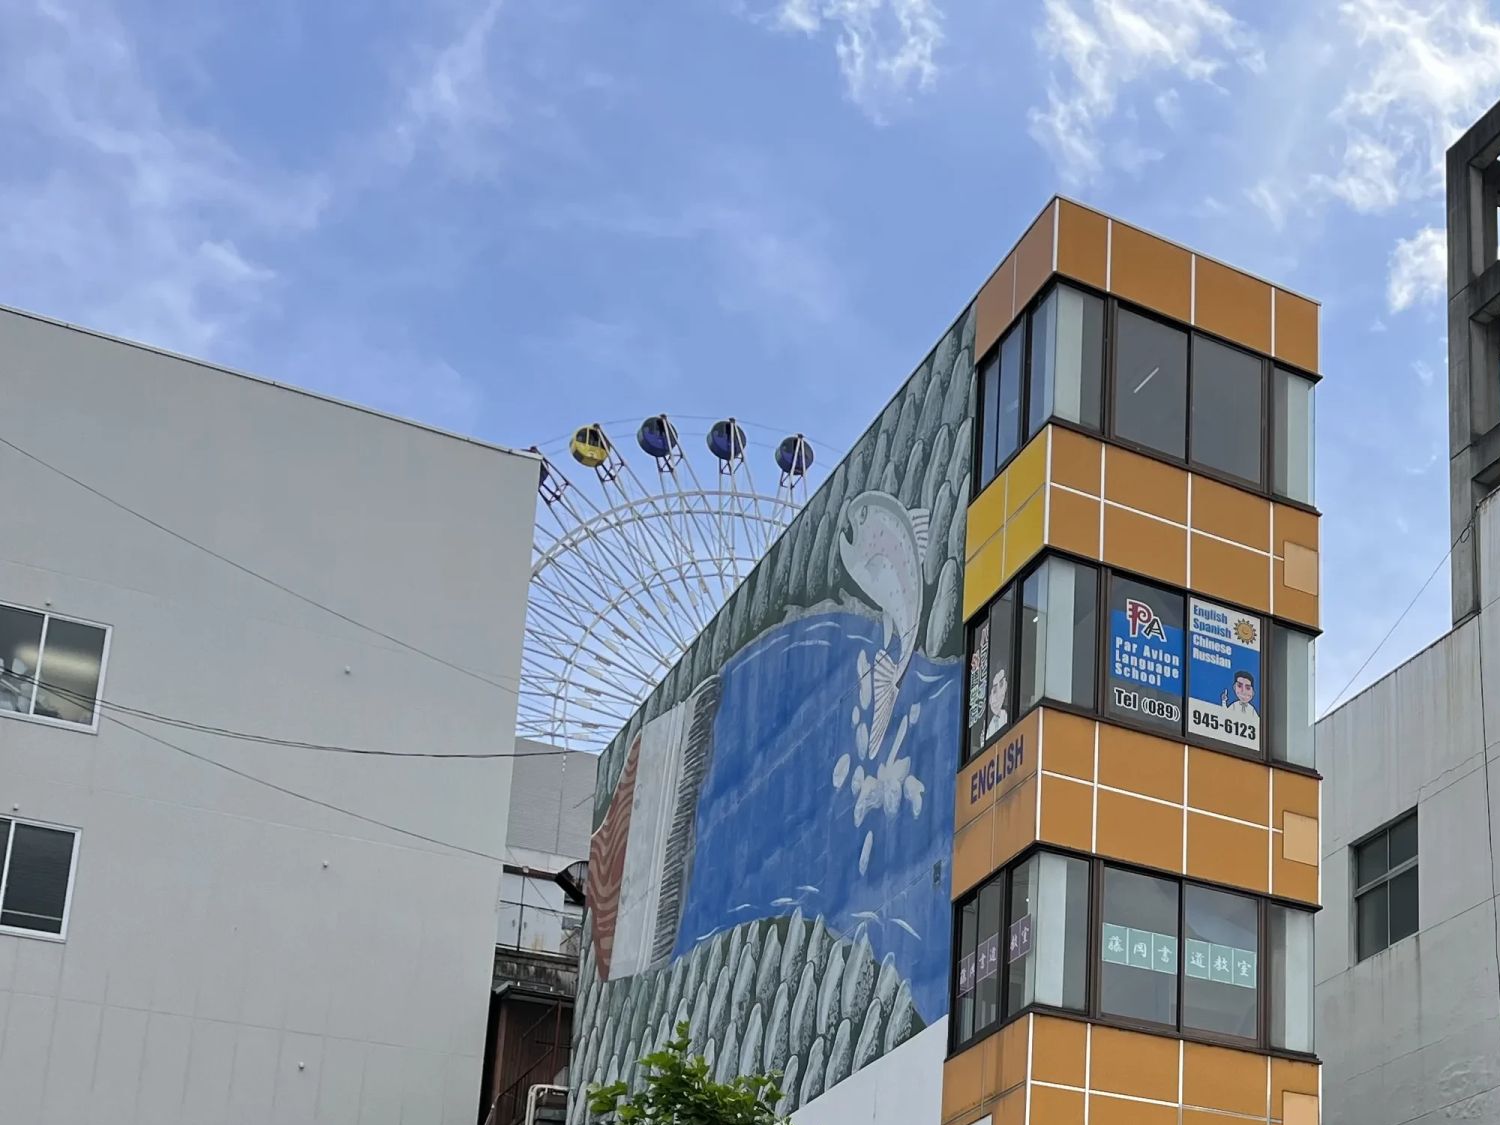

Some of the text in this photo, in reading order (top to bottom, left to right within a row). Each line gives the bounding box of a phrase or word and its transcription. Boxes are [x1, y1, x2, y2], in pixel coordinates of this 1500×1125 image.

[1193, 604, 1228, 624] English
[1193, 618, 1232, 639] Spanish
[1115, 637, 1179, 666] Par Avion
[1193, 634, 1232, 656] Chinese
[1115, 650, 1179, 679] Language
[1193, 648, 1232, 669] Russian
[1115, 662, 1161, 686] School
[1114, 687, 1180, 721] Tel (089)
[1193, 710, 1256, 740] 945-6123
[970, 734, 1024, 805] ENGLISH
